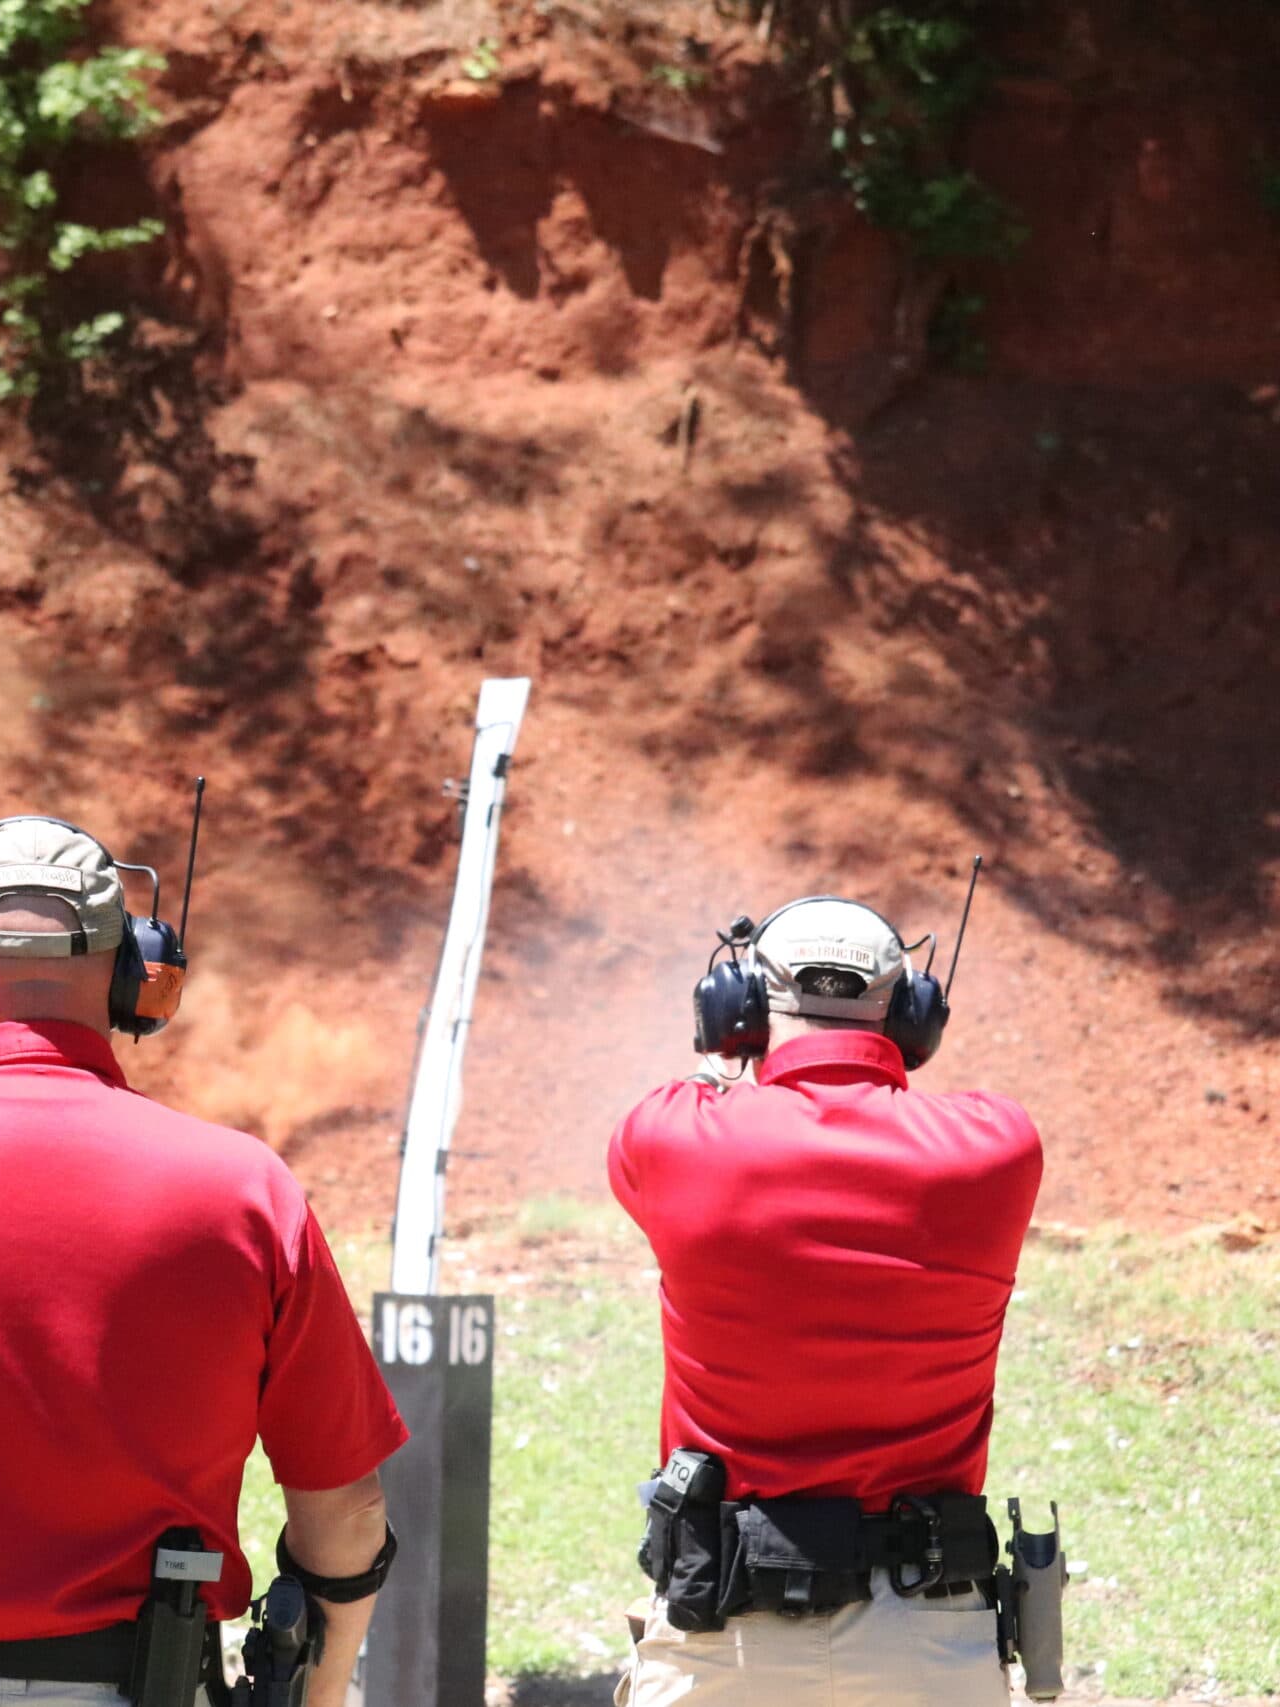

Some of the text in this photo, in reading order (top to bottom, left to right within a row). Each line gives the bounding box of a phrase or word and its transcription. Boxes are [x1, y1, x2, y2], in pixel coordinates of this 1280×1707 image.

[382, 1301, 487, 1365] 16 16
[671, 1460, 690, 1483] TQ
